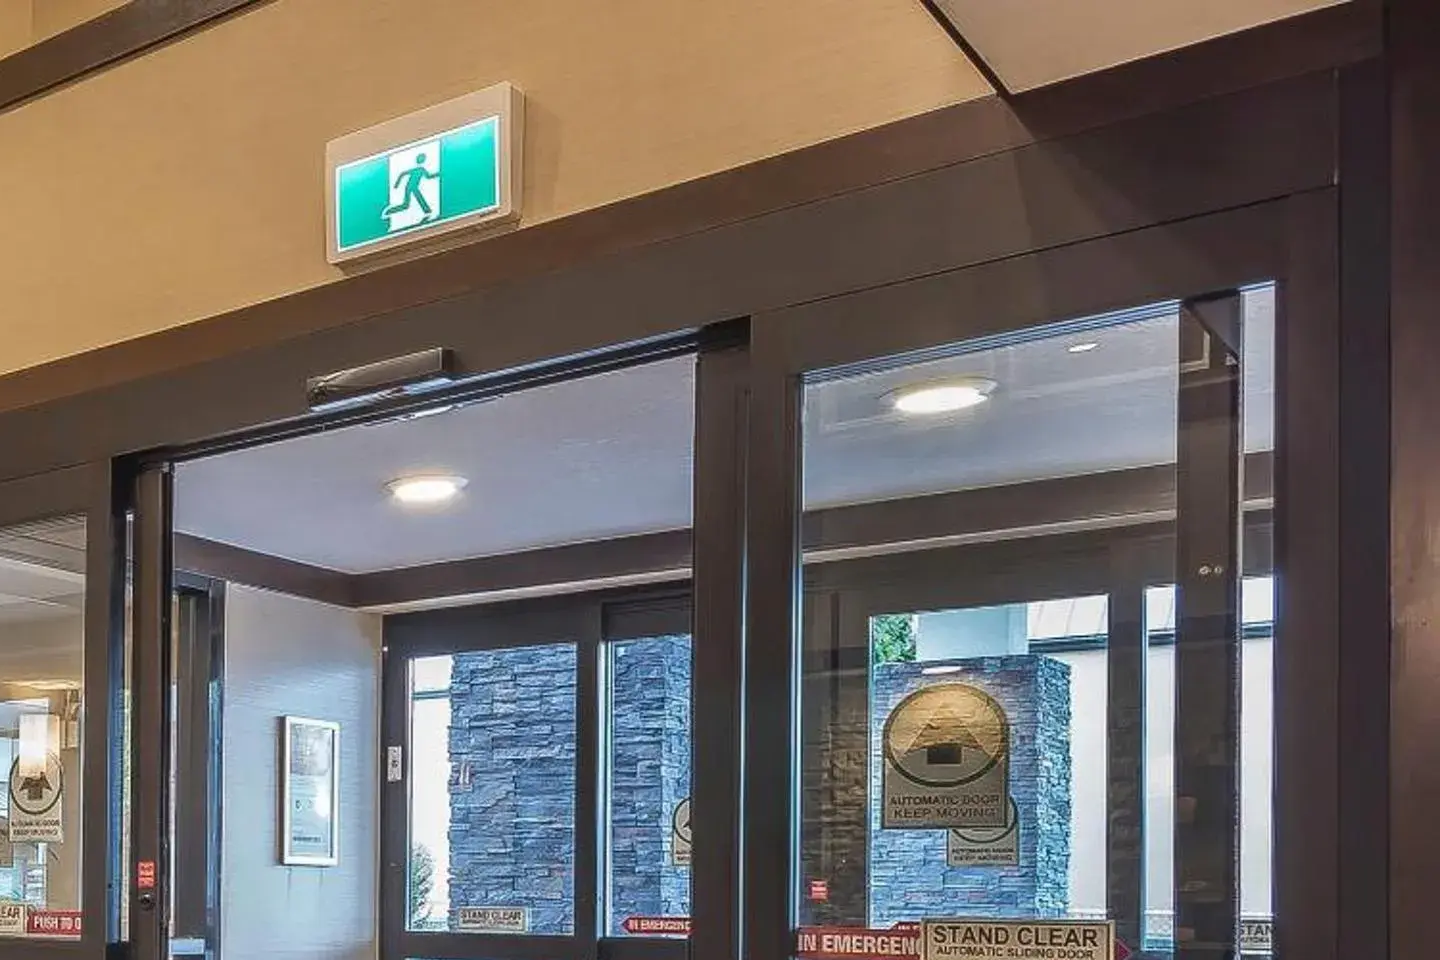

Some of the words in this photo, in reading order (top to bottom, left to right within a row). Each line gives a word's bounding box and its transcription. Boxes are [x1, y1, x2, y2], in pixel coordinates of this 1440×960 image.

[890, 794, 959, 805] AUTOMATIC
[963, 794, 999, 804] DOOR
[893, 807, 931, 818] KEEP
[936, 807, 996, 818] MOVING
[34, 916, 58, 930] PUSH
[933, 925, 1009, 945] STAND
[1017, 927, 1099, 947] CLEAR
[798, 934, 817, 951] IN
[821, 934, 921, 955] EMERGEN
[936, 946, 1003, 957] AUTOMATIC
[1007, 947, 1054, 959] SLIDING
[1057, 949, 1094, 960] DOOR
